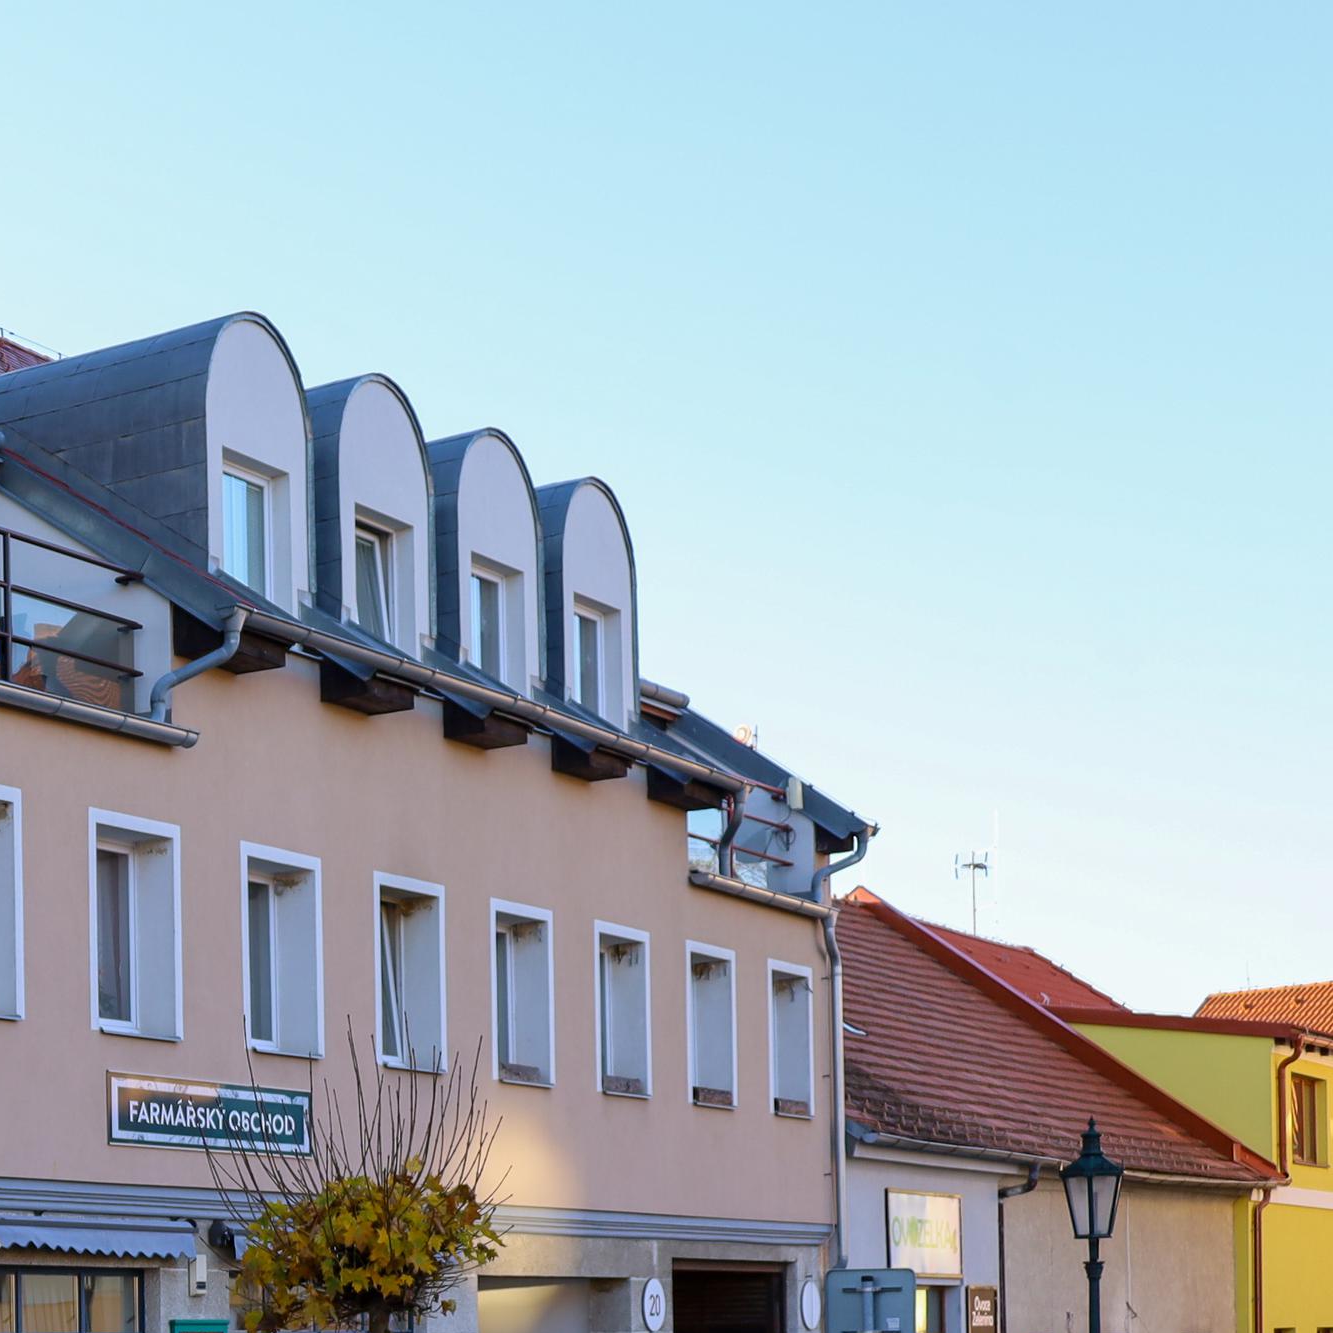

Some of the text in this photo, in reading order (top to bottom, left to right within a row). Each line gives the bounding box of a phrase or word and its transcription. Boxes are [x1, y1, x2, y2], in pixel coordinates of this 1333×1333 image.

[129, 1097, 295, 1136] FARMÁŘSKÝ OBCHOD
[649, 1294, 661, 1316] 20
